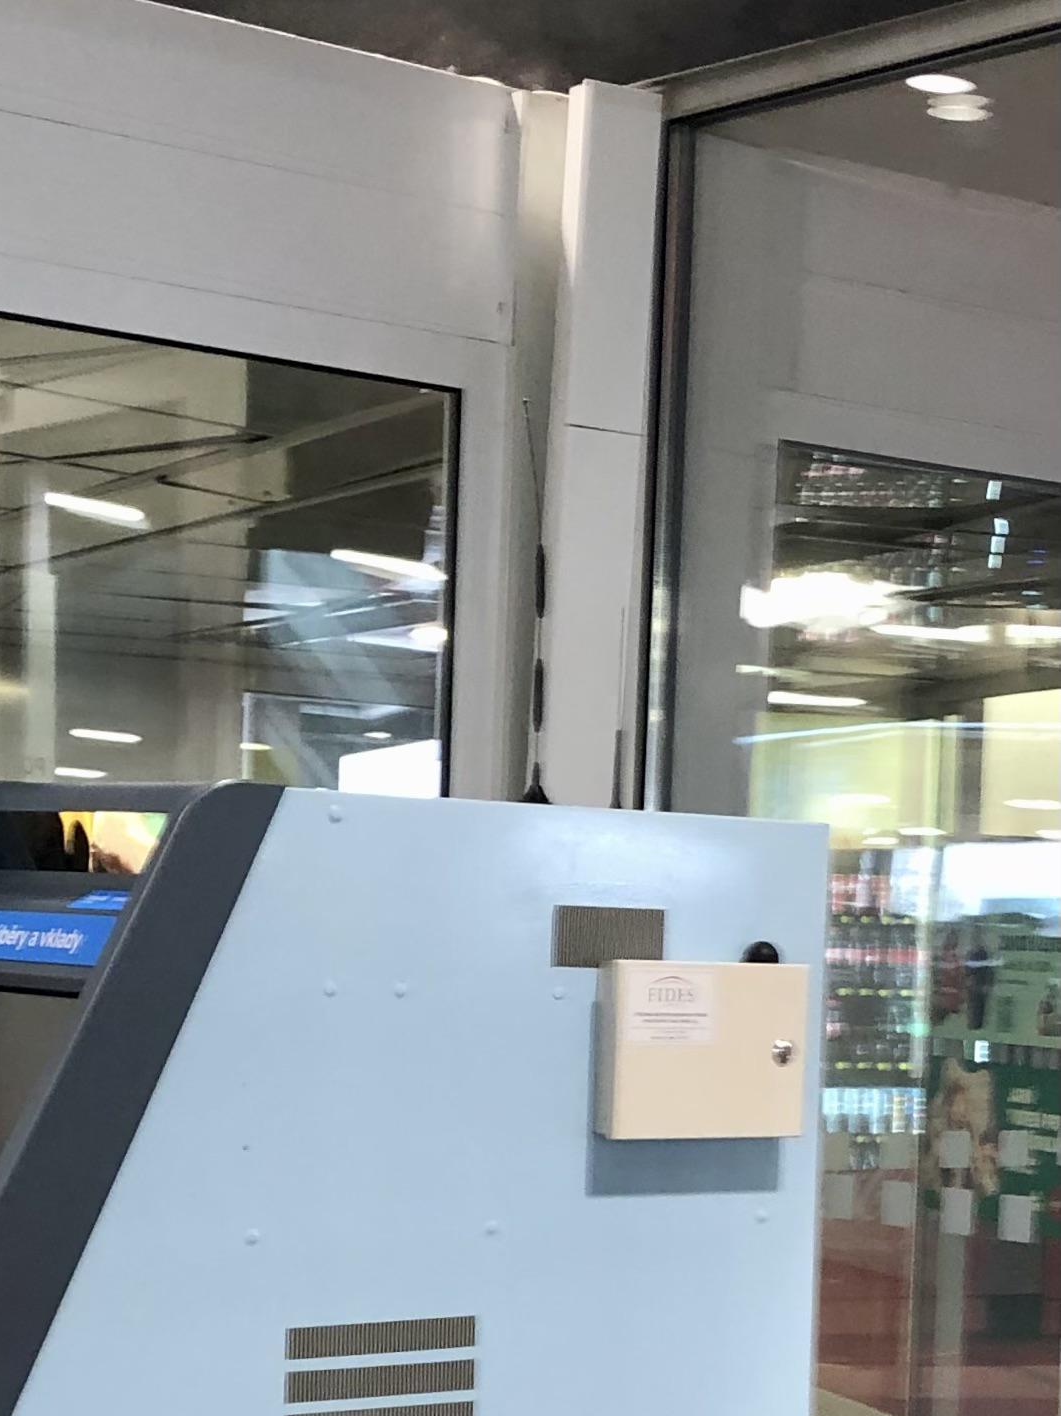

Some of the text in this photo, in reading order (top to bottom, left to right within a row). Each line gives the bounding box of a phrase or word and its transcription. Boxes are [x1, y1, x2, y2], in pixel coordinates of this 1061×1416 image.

[28, 931, 38, 947] a
[40, 928, 84, 955] vklady
[648, 987, 697, 1003] FIDES
